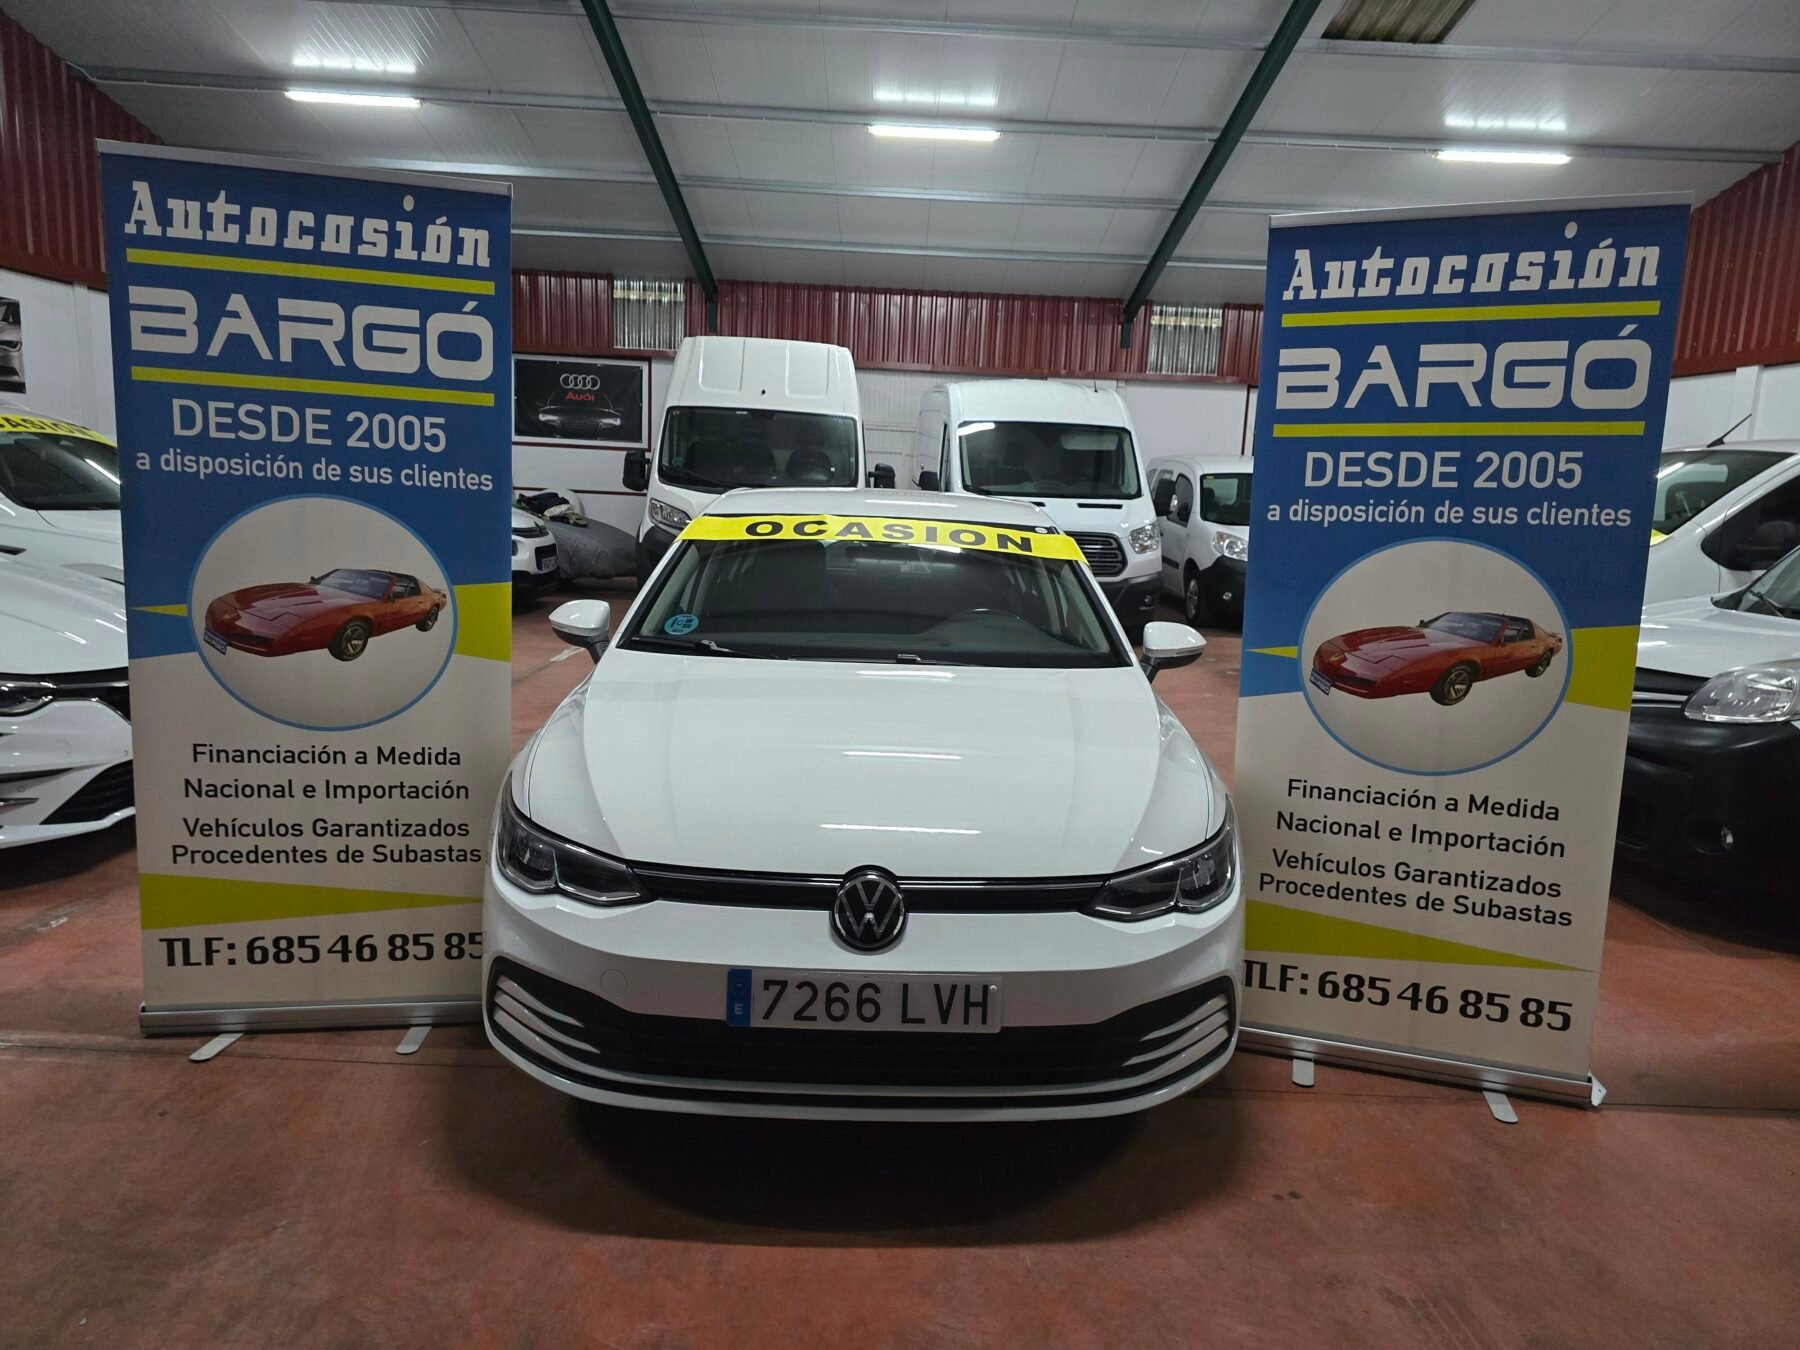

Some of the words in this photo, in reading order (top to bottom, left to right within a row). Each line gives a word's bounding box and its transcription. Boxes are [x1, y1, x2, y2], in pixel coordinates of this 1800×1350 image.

[125, 181, 491, 268] Autocasión
[1282, 221, 1660, 301] Autocasión
[128, 285, 495, 382] BARGÓ
[1276, 324, 1652, 410] BARGÓ
[565, 391, 595, 401] Audi
[0, 416, 96, 440] ASION
[173, 399, 331, 445] DESDE
[347, 411, 445, 452] 2005
[136, 453, 150, 470] a
[160, 450, 303, 480] disposición
[313, 458, 341, 481] de
[349, 466, 392, 484] sus
[401, 464, 492, 490] clientes
[1305, 452, 1460, 487] DESDE
[1474, 451, 1583, 488] 2005
[1268, 505, 1280, 520] a
[1290, 499, 1424, 527] disposición
[1435, 500, 1463, 523] de
[1472, 507, 1517, 524] sus
[1527, 502, 1631, 526] clientes
[744, 518, 1033, 553] OCASION
[193, 744, 346, 764] Financiación
[355, 751, 367, 764] a
[377, 746, 460, 765] Medida
[184, 778, 295, 798] Nacional
[303, 785, 316, 798] e
[326, 780, 468, 804] Importación
[1288, 779, 1436, 810] Financiación
[1445, 798, 1458, 812] a
[1468, 794, 1559, 821] Medida
[183, 818, 303, 837] Vehículos
[313, 818, 469, 837] Garantizados
[1277, 811, 1380, 839] Nacional
[1389, 827, 1402, 841] e
[1412, 824, 1564, 857] Importación
[172, 845, 327, 864] Procedentes
[336, 846, 364, 864] de
[372, 845, 482, 864] Subastas
[1272, 848, 1386, 880] Vehículos
[1394, 862, 1562, 899] Garantizados
[1259, 873, 1408, 909] Procedentes
[1416, 891, 1444, 911] de
[1453, 895, 1573, 927] Subastas
[159, 937, 236, 966] TLF:
[247, 936, 320, 964] 685
[327, 935, 377, 962] 46
[388, 933, 434, 961] 85
[735, 1004, 743, 1014] E
[763, 980, 880, 1022] 7266
[902, 983, 988, 1025] LVH
[1244, 960, 1308, 995] TLF:
[1318, 971, 1391, 1006] 685
[1397, 983, 1448, 1014] 46
[1459, 990, 1510, 1022] 85
[1520, 998, 1572, 1031] 85
